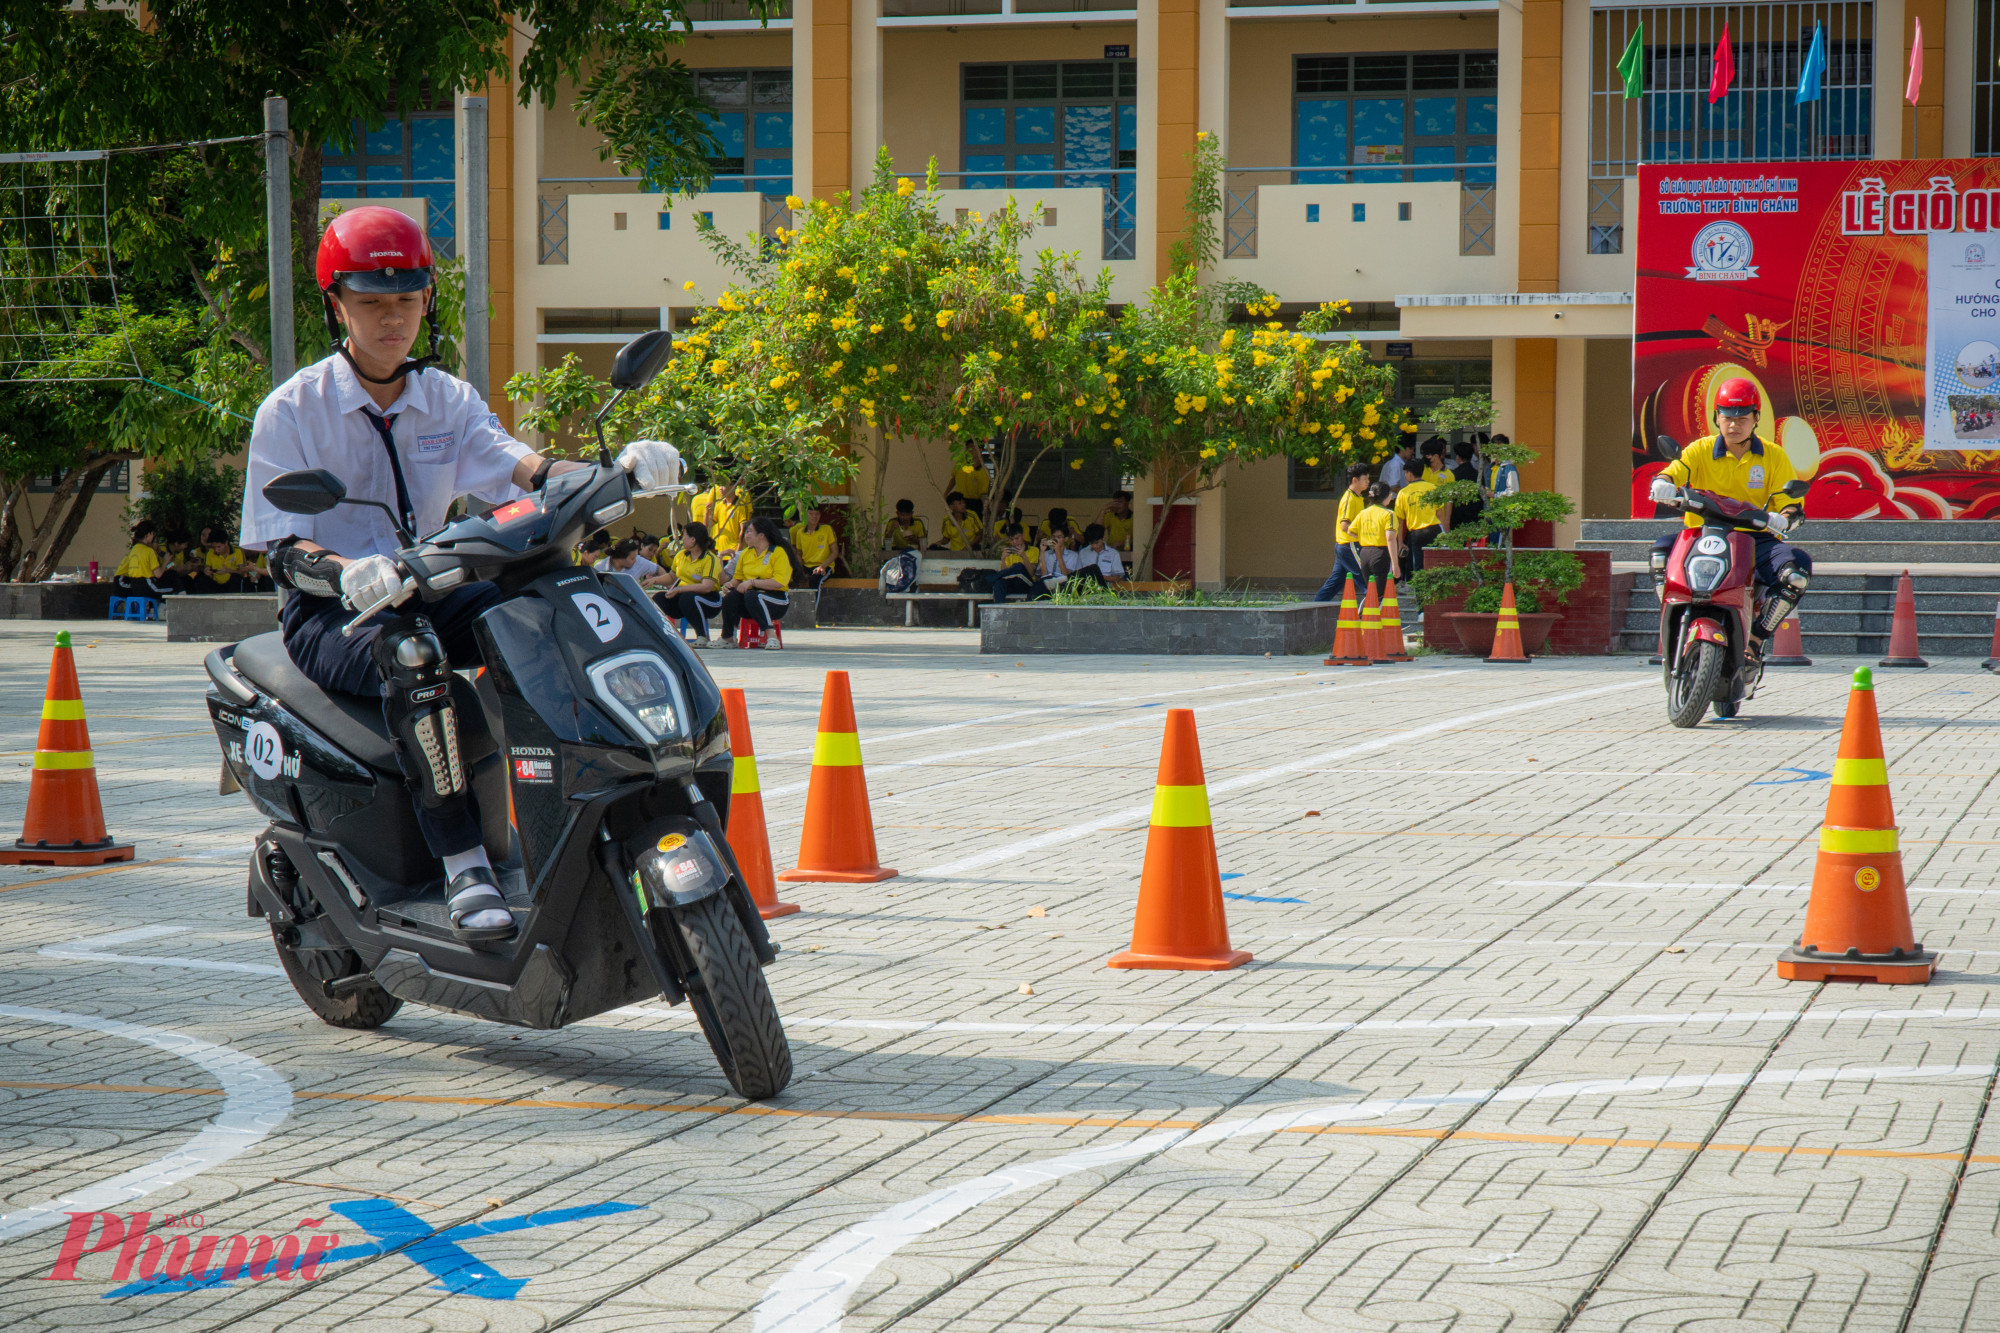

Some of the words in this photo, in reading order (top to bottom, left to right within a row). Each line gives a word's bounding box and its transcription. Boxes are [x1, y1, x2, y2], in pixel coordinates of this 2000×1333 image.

[1670, 177, 1687, 193] GIÁO
[1688, 179, 1702, 196] DỤC
[1703, 177, 1712, 193] VÀ
[1714, 177, 1728, 193] ĐÀO
[1729, 179, 1742, 196] TẠO
[1765, 176, 1778, 192] CHÍ
[1779, 178, 1798, 192] MINH
[1659, 198, 1701, 214] TRƯỜNG
[1703, 200, 1730, 214] THPT
[1732, 197, 1758, 213] BÌNH
[1761, 196, 1798, 213] CHÁNH
[1842, 176, 1888, 235] LỄ
[1889, 176, 1959, 234] GIỖ
[1698, 271, 1716, 280] BÌNH
[1718, 270, 1746, 280] CHÁNH
[1956, 293, 2000, 304] HƯỚNG
[1971, 308, 1996, 318] CHO
[1704, 540, 1720, 550] 07
[556, 575, 590, 586] HONDA
[585, 602, 610, 628] 2
[218, 709, 242, 727] ICON
[230, 740, 243, 764] XE
[253, 733, 274, 766] 02
[511, 746, 556, 756] HONDA
[516, 760, 535, 776] +84
